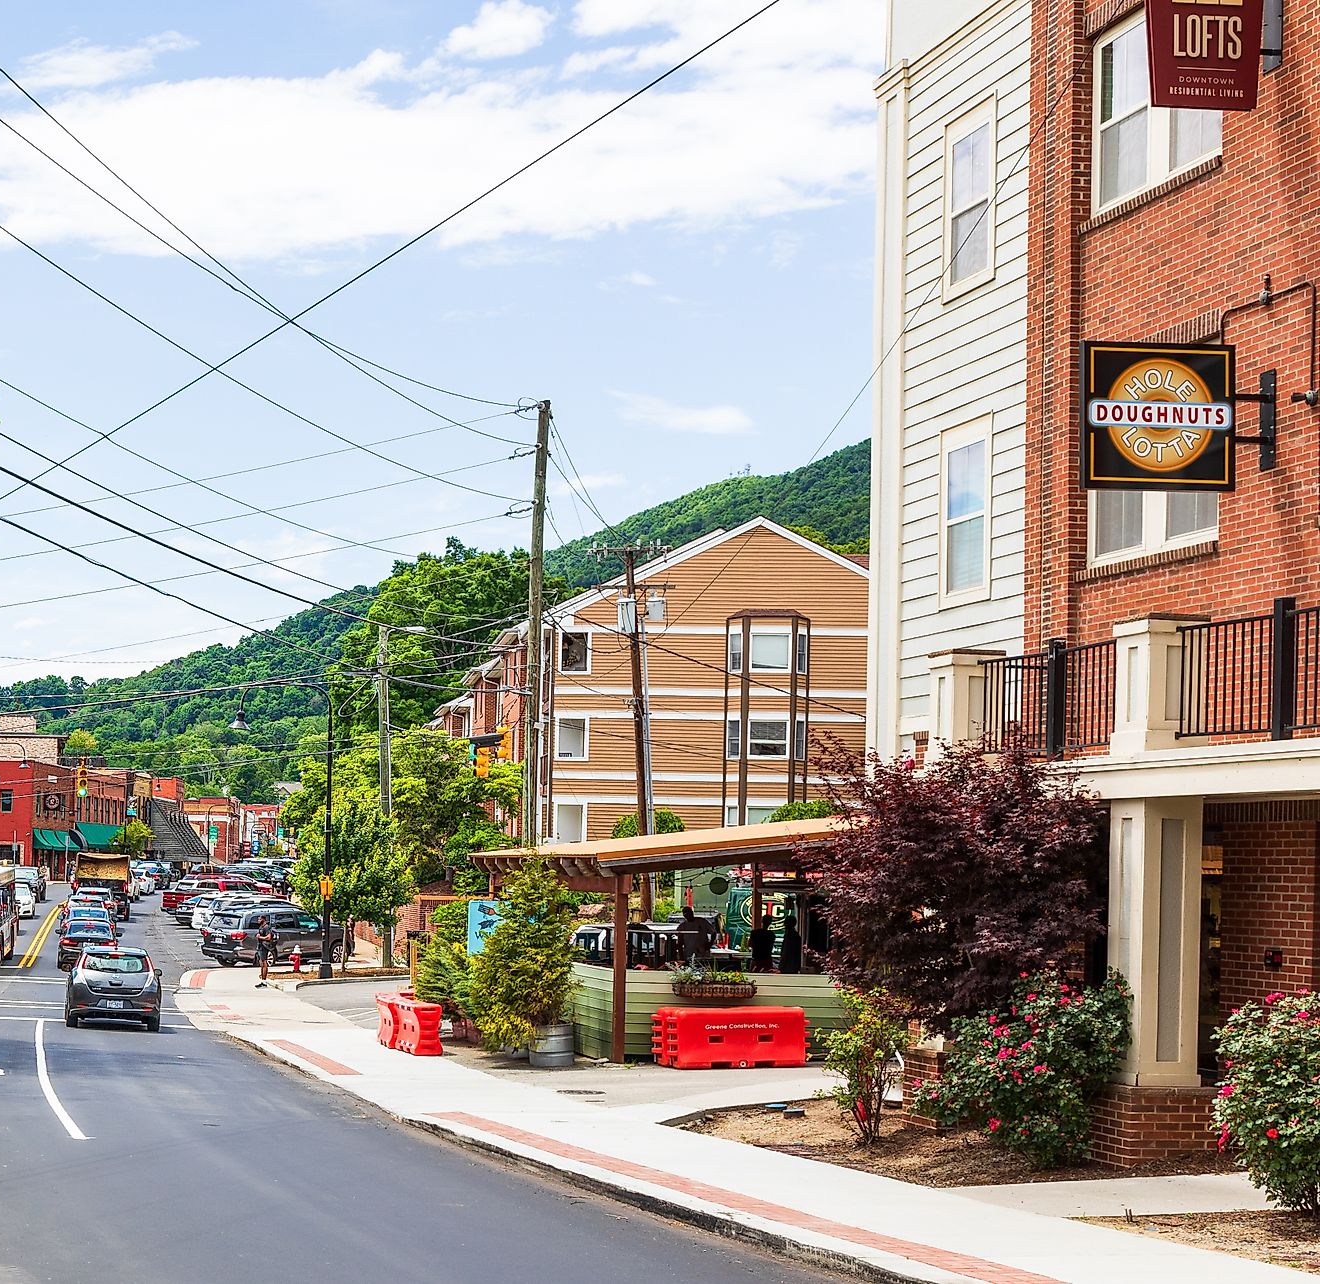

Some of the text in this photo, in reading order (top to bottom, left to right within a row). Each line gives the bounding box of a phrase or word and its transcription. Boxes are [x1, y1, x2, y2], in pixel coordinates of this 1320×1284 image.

[1173, 13, 1242, 59] LOFTS
[1169, 86, 1244, 98] RESIDENTIAL LIVING
[1178, 75, 1234, 85] DOWNTOWN
[1124, 369, 1197, 402] HOLE
[1096, 404, 1225, 425] DOUGHNUTS
[1121, 426, 1201, 462] LOTTA
